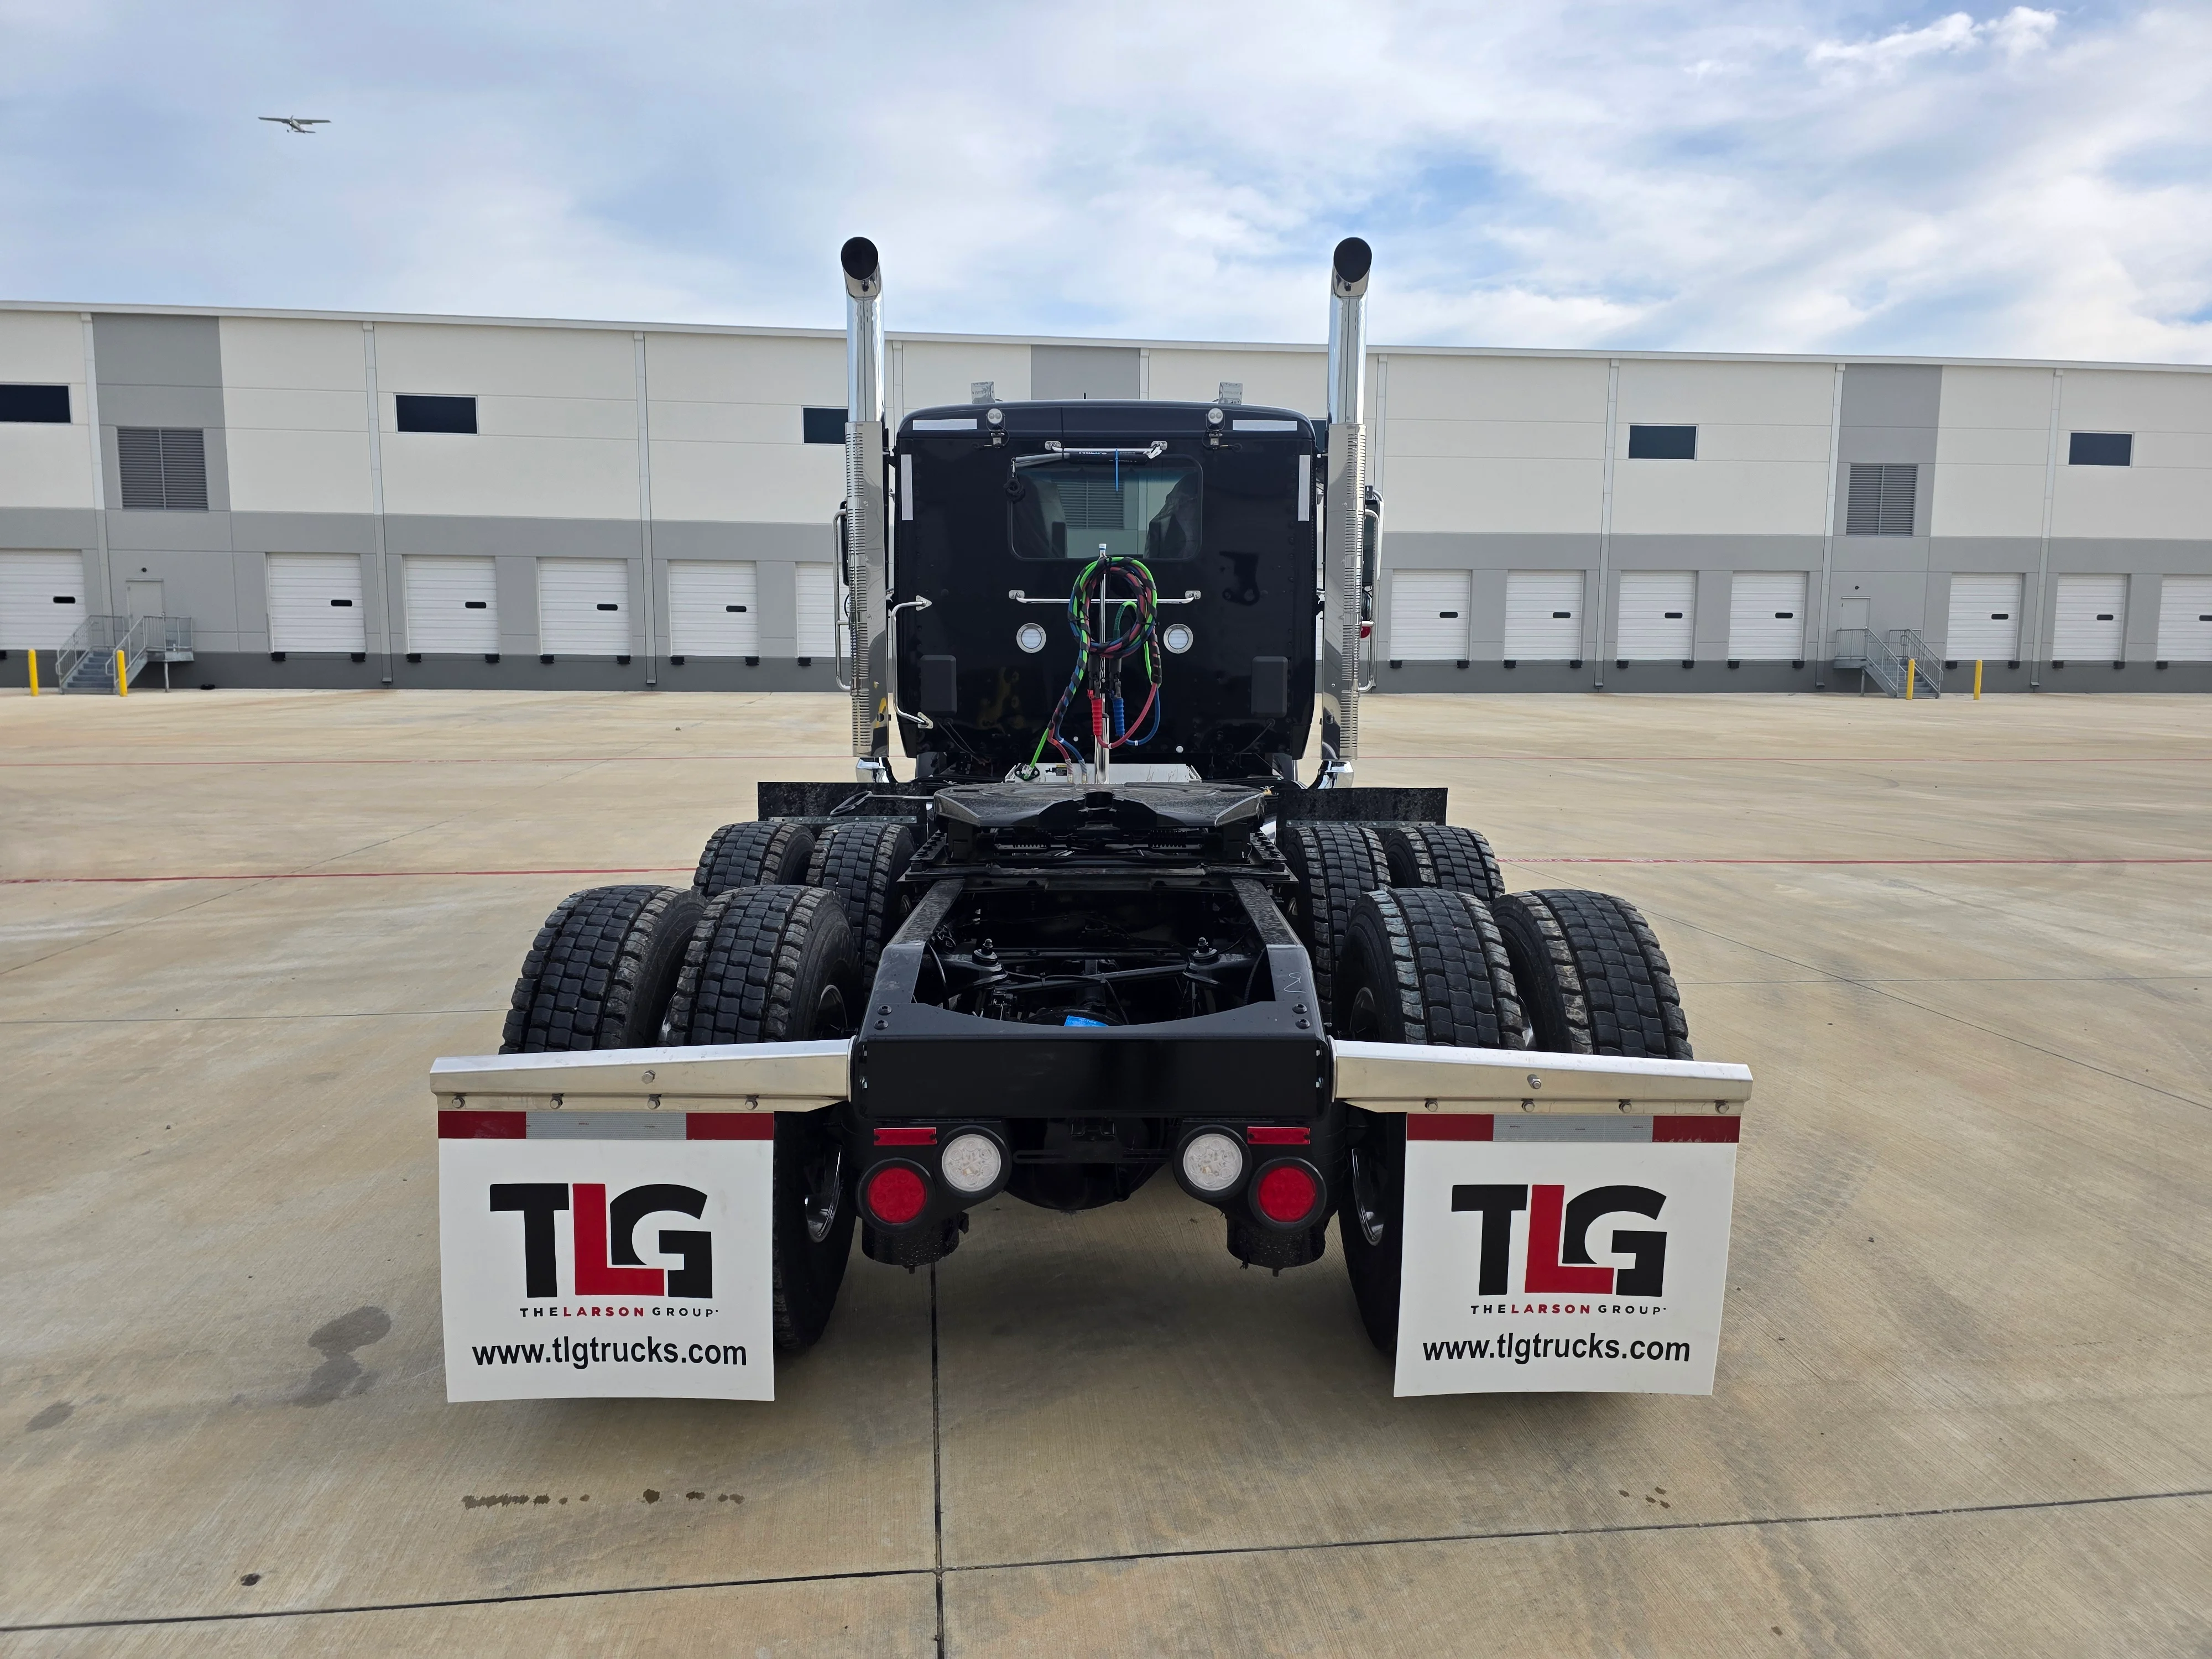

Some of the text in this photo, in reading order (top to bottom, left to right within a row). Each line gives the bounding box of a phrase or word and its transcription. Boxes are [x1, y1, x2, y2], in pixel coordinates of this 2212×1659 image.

[489, 1183, 713, 1299] TLG
[1451, 1184, 1667, 1297] TLG
[472, 1335, 747, 1370] www.tlgtrucks.com
[1422, 1332, 1690, 1365] www.tlgtrucks.com
